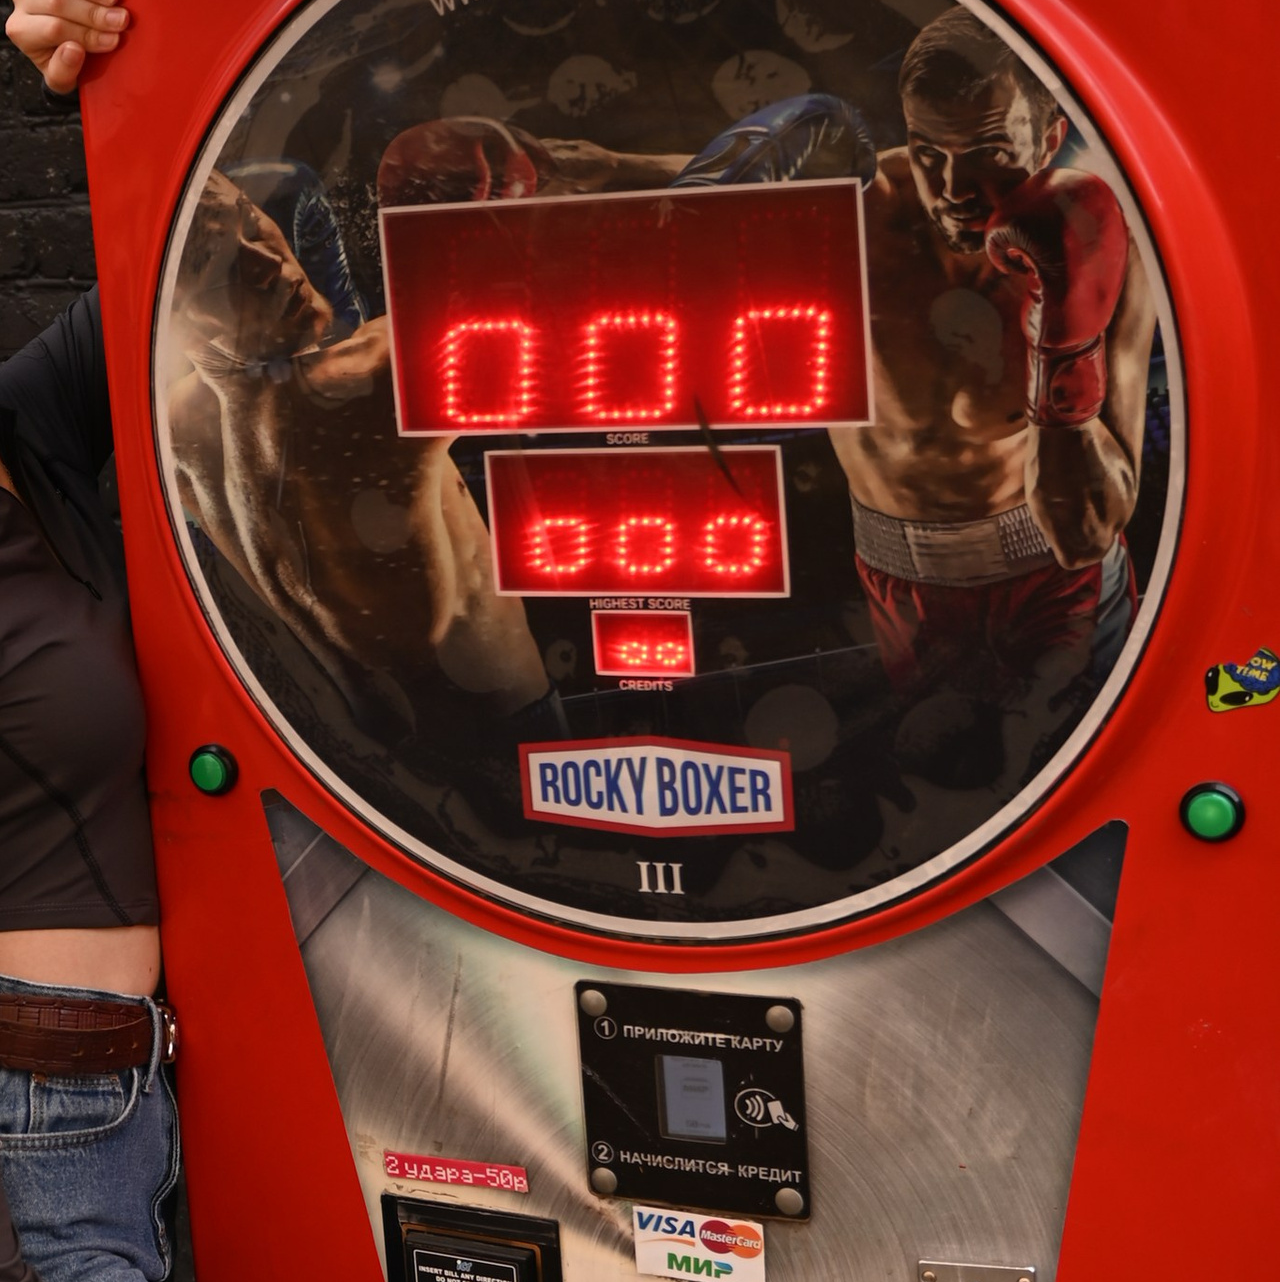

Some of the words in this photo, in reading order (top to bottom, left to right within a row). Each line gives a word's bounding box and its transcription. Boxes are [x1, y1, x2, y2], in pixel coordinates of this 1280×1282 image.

[606, 433, 650, 446] SCORE
[589, 598, 645, 610] HIGHEST
[647, 599, 691, 611] SCORE
[619, 680, 674, 692] CREDITS
[538, 755, 649, 816] ROCKY
[654, 756, 773, 817] BOXER
[635, 860, 686, 895] III
[623, 1025, 727, 1048] ПРИЛОЖИТЕ
[730, 1035, 784, 1053] КАРТУ
[385, 1156, 400, 1175] 2
[619, 1149, 730, 1177] НАЧИСЛИТСЯ
[737, 1164, 803, 1184] КРЕДИТ
[636, 1211, 696, 1239] VISA
[700, 1228, 762, 1250] MasterCard
[418, 1265, 443, 1276] INSERT
[444, 1269, 460, 1279] BILL
[460, 1273, 475, 1281] ANY
[666, 1252, 734, 1279] МИР
